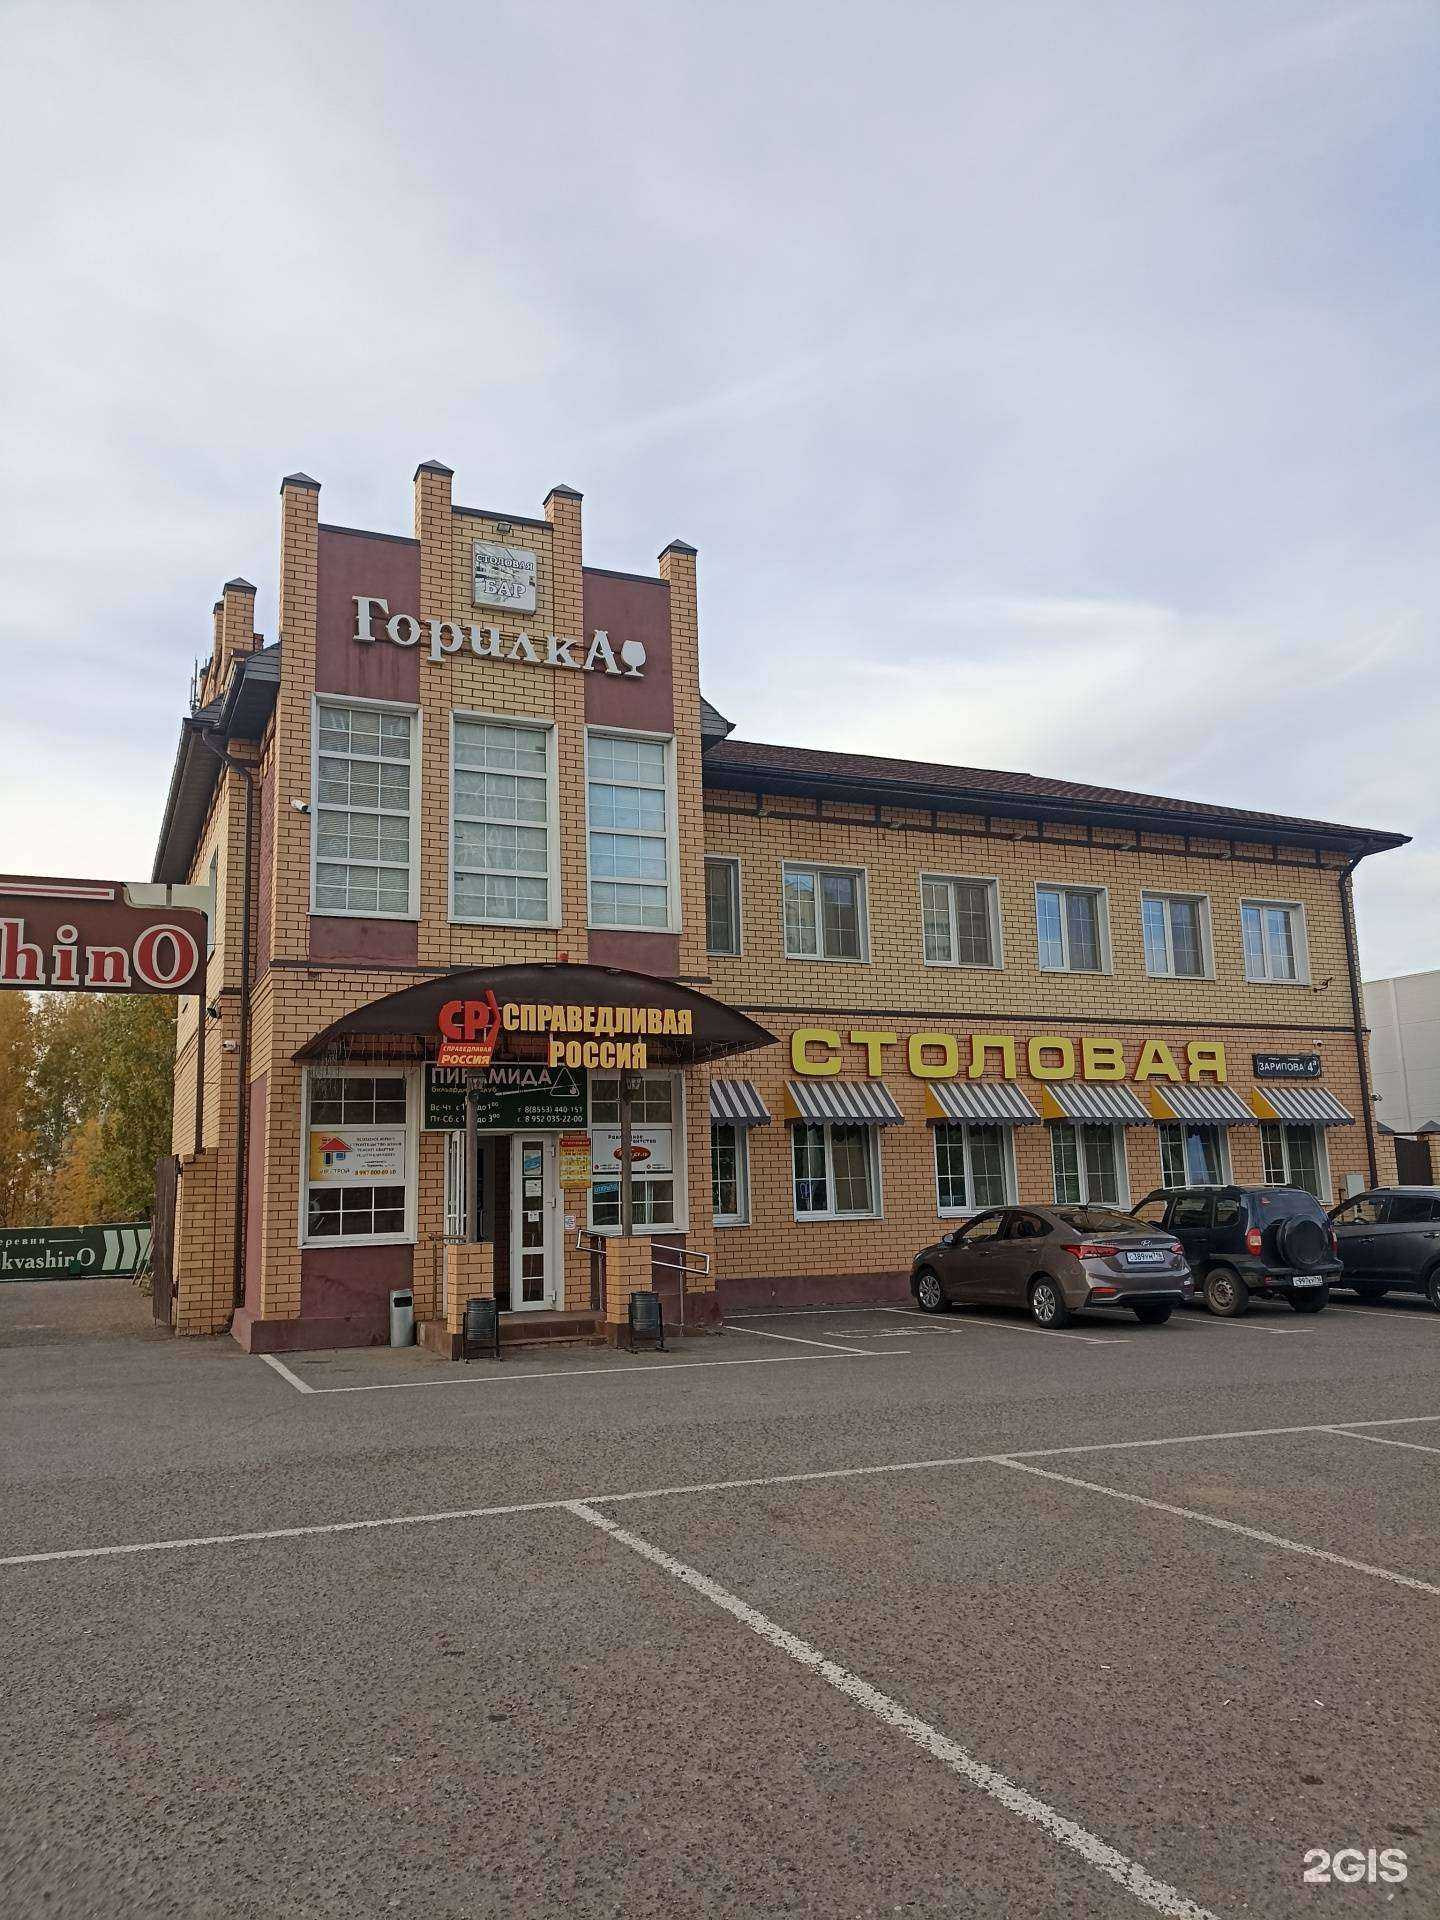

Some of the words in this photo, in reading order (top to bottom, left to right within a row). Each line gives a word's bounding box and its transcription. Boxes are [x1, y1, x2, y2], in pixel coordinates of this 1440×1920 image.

[476, 553, 534, 571] СТОЛОВАЯ
[484, 578, 527, 598] БАР
[502, 1003, 693, 1036] СПРАВЕДЛИВАЯ
[441, 1054, 490, 1064] РОССИЯ
[549, 1040, 647, 1068] РОССИЯ
[790, 1028, 1228, 1082] СТОЛОВАЯ
[1259, 1062, 1305, 1071] ЗАРИПОВА
[431, 1067, 551, 1086] ПИРМИДА
